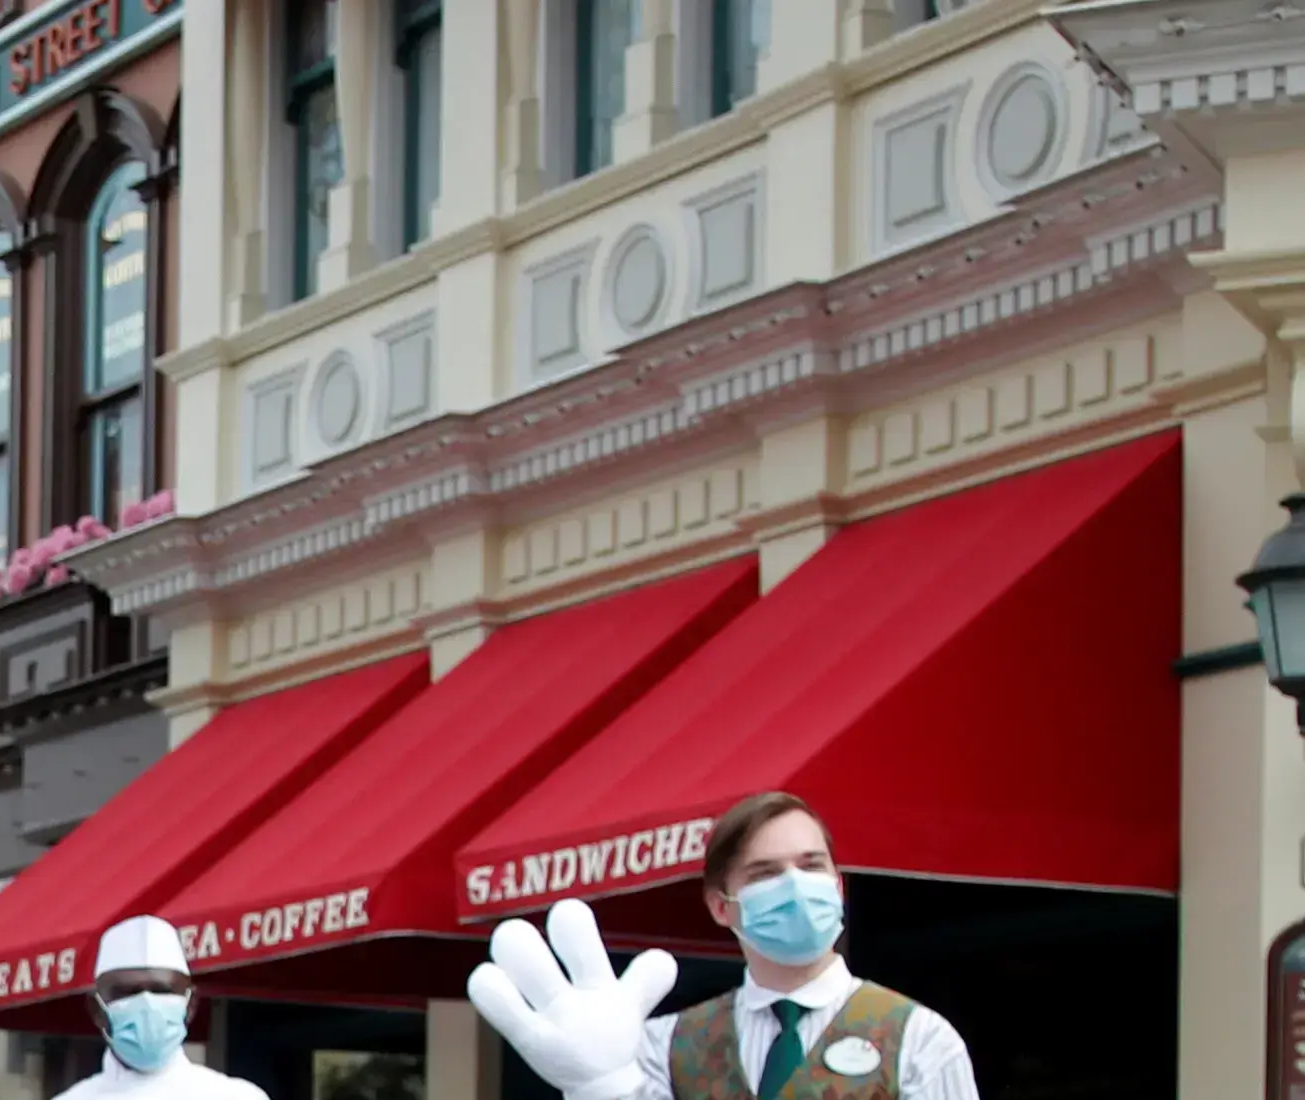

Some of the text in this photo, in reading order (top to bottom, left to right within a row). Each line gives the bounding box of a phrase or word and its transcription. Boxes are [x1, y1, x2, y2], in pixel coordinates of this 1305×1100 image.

[9, 0, 122, 95] STREET
[465, 817, 715, 905] SANDWICHE
[178, 886, 371, 961] EA COFFEE
